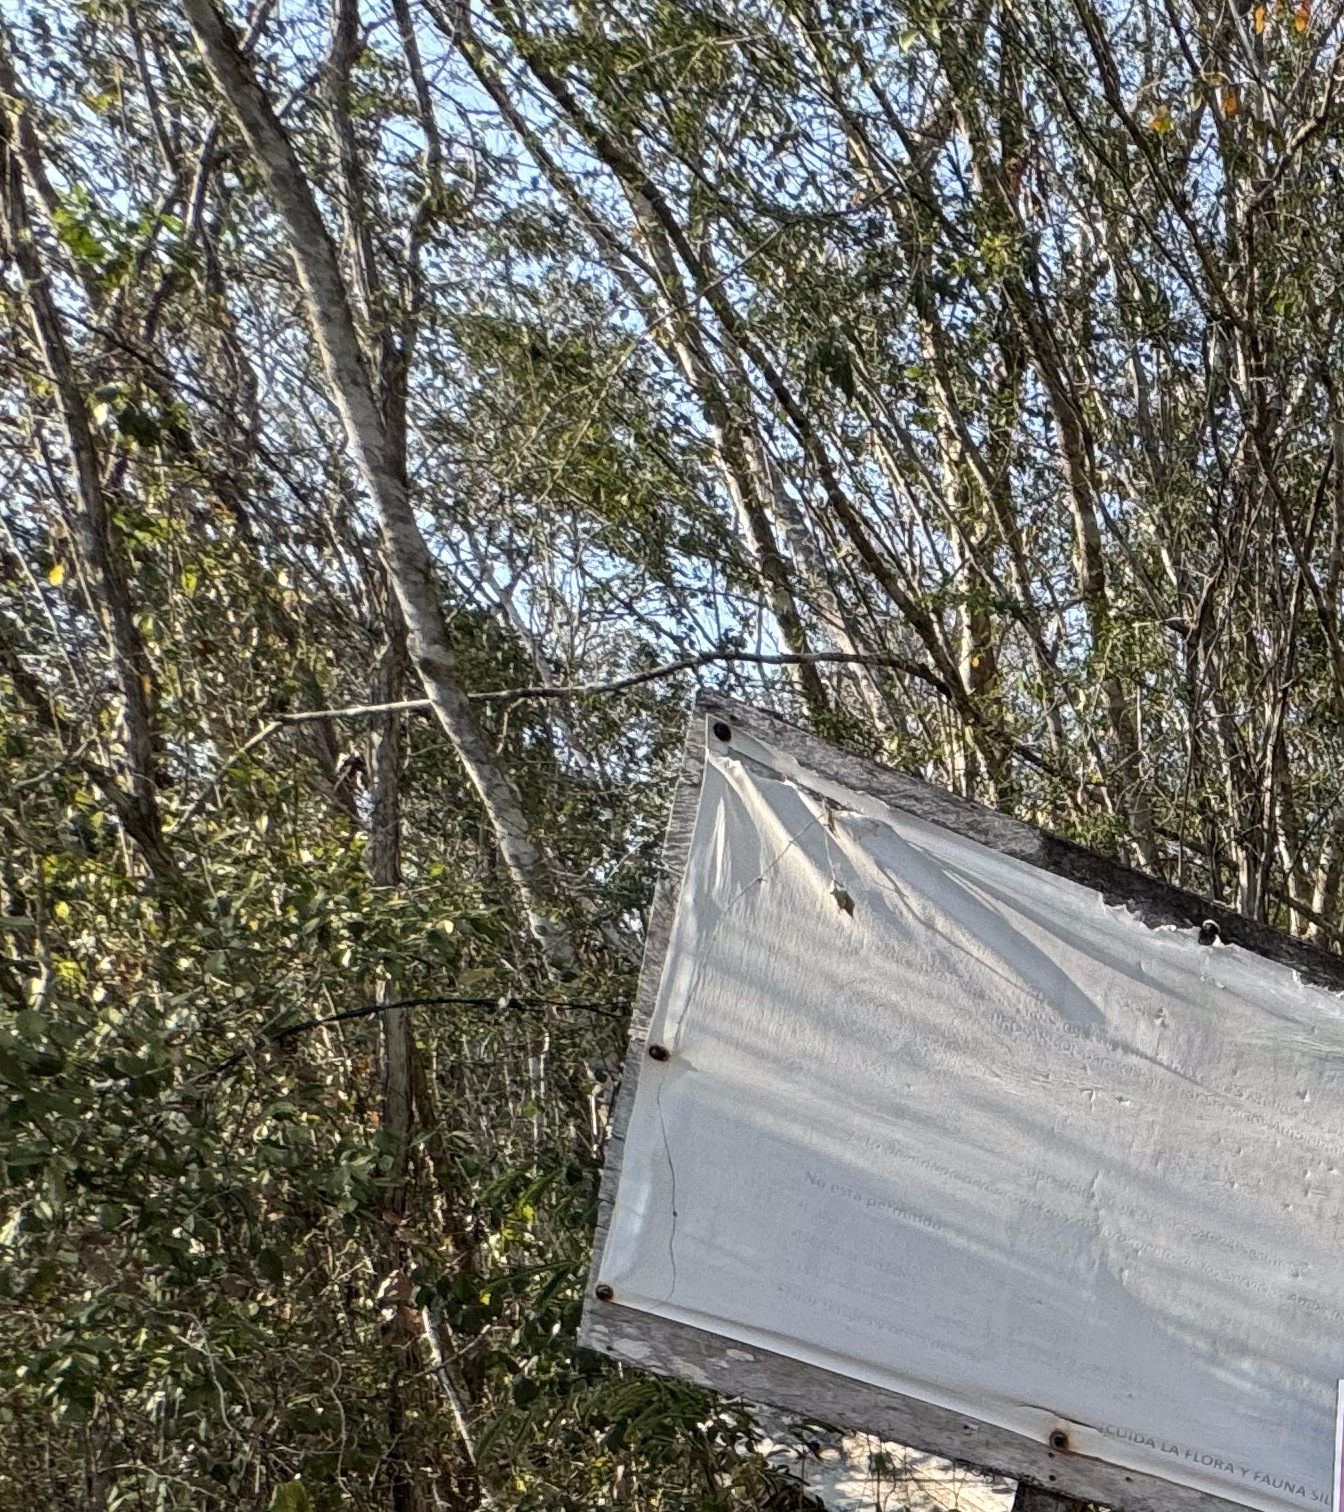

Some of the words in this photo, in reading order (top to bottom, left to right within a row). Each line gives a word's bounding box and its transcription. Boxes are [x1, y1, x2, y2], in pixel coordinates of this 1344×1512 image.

[1161, 1443, 1180, 1457] LA
[1185, 1450, 1234, 1474] FLORA
[1240, 1466, 1251, 1478] Y
[1254, 1471, 1307, 1498] FAUNA
